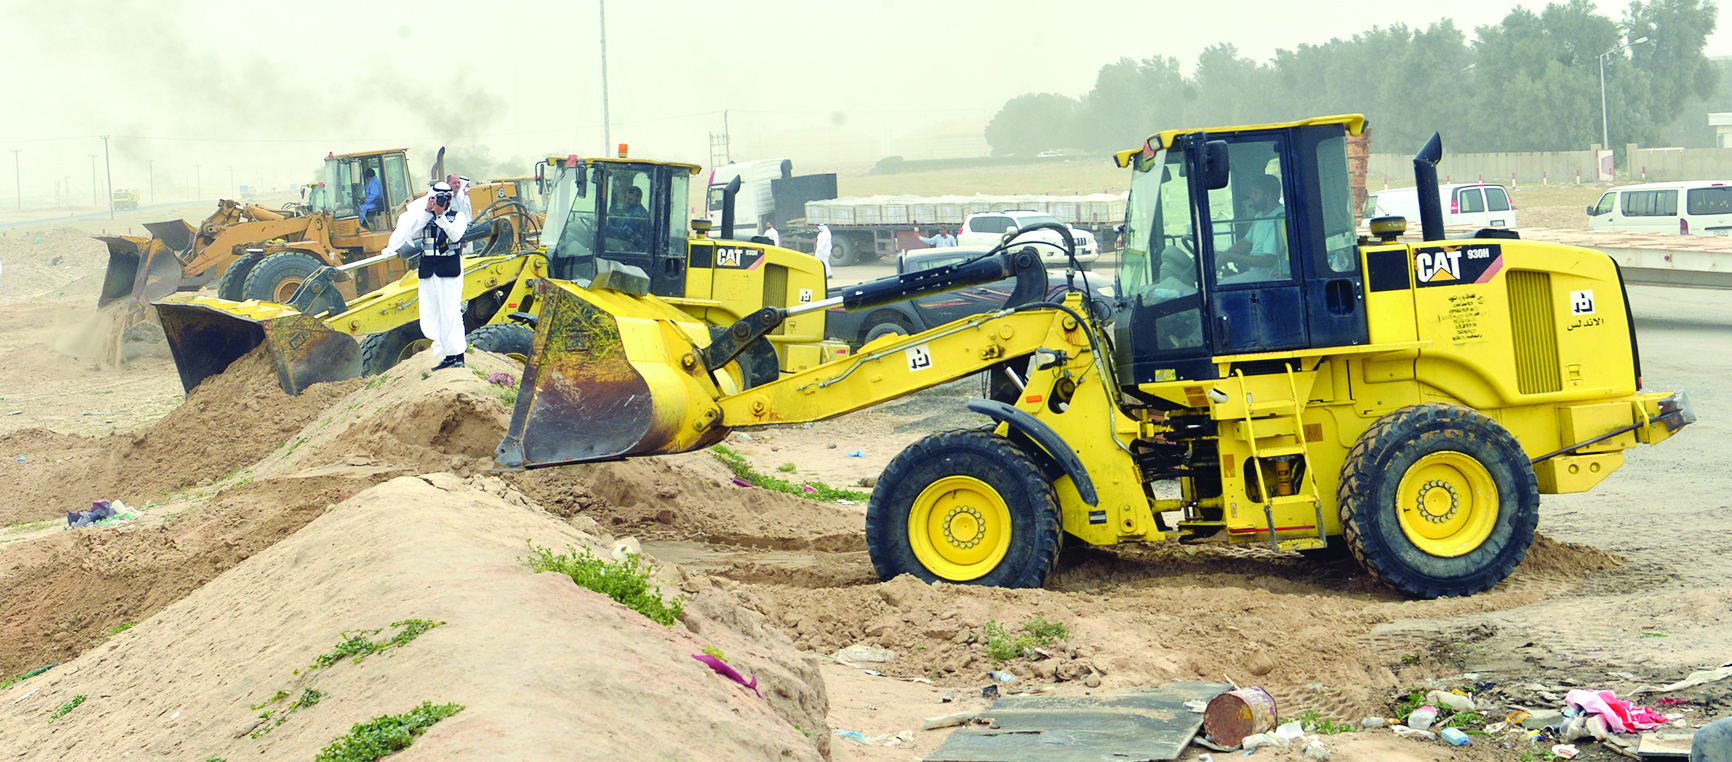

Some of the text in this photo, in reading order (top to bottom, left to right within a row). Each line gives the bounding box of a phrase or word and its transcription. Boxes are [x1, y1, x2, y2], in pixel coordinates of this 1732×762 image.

[717, 248, 743, 266] CAT
[1467, 248, 1490, 259] 930H
[1416, 250, 1462, 282] CAT
